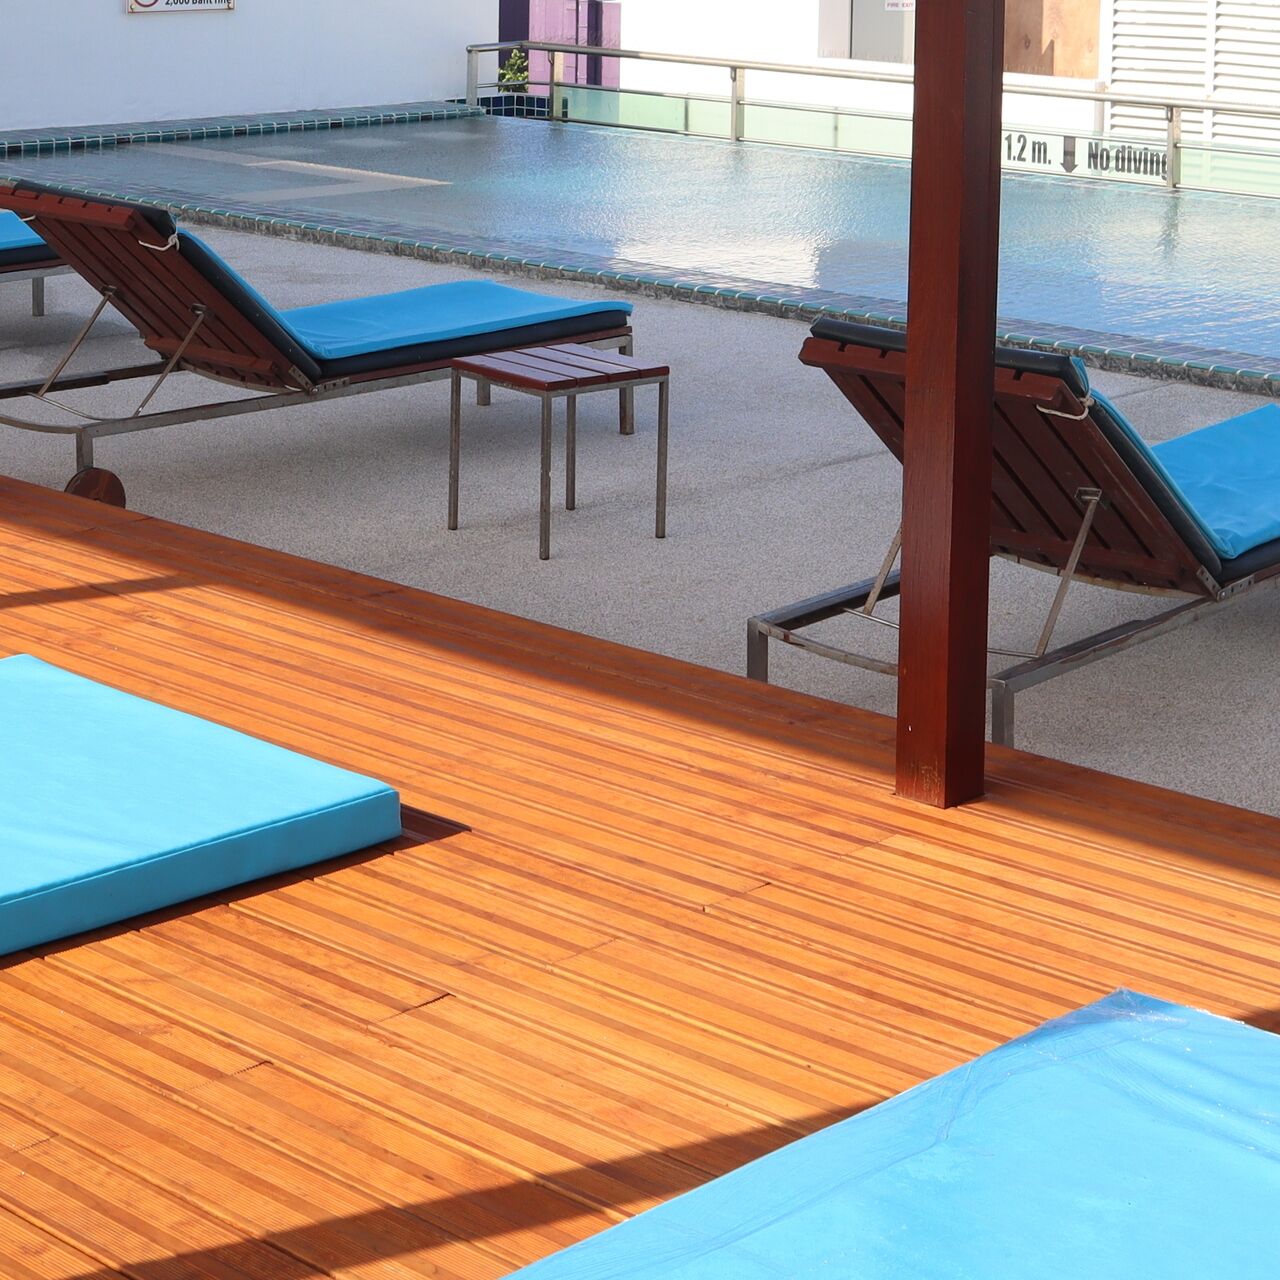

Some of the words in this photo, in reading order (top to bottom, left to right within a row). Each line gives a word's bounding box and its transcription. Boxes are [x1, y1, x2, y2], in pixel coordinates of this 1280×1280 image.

[1004, 133, 1027, 162] 1.2
[1031, 140, 1052, 165] m.
[1087, 141, 1110, 171] No
[1115, 145, 1168, 181] diving
